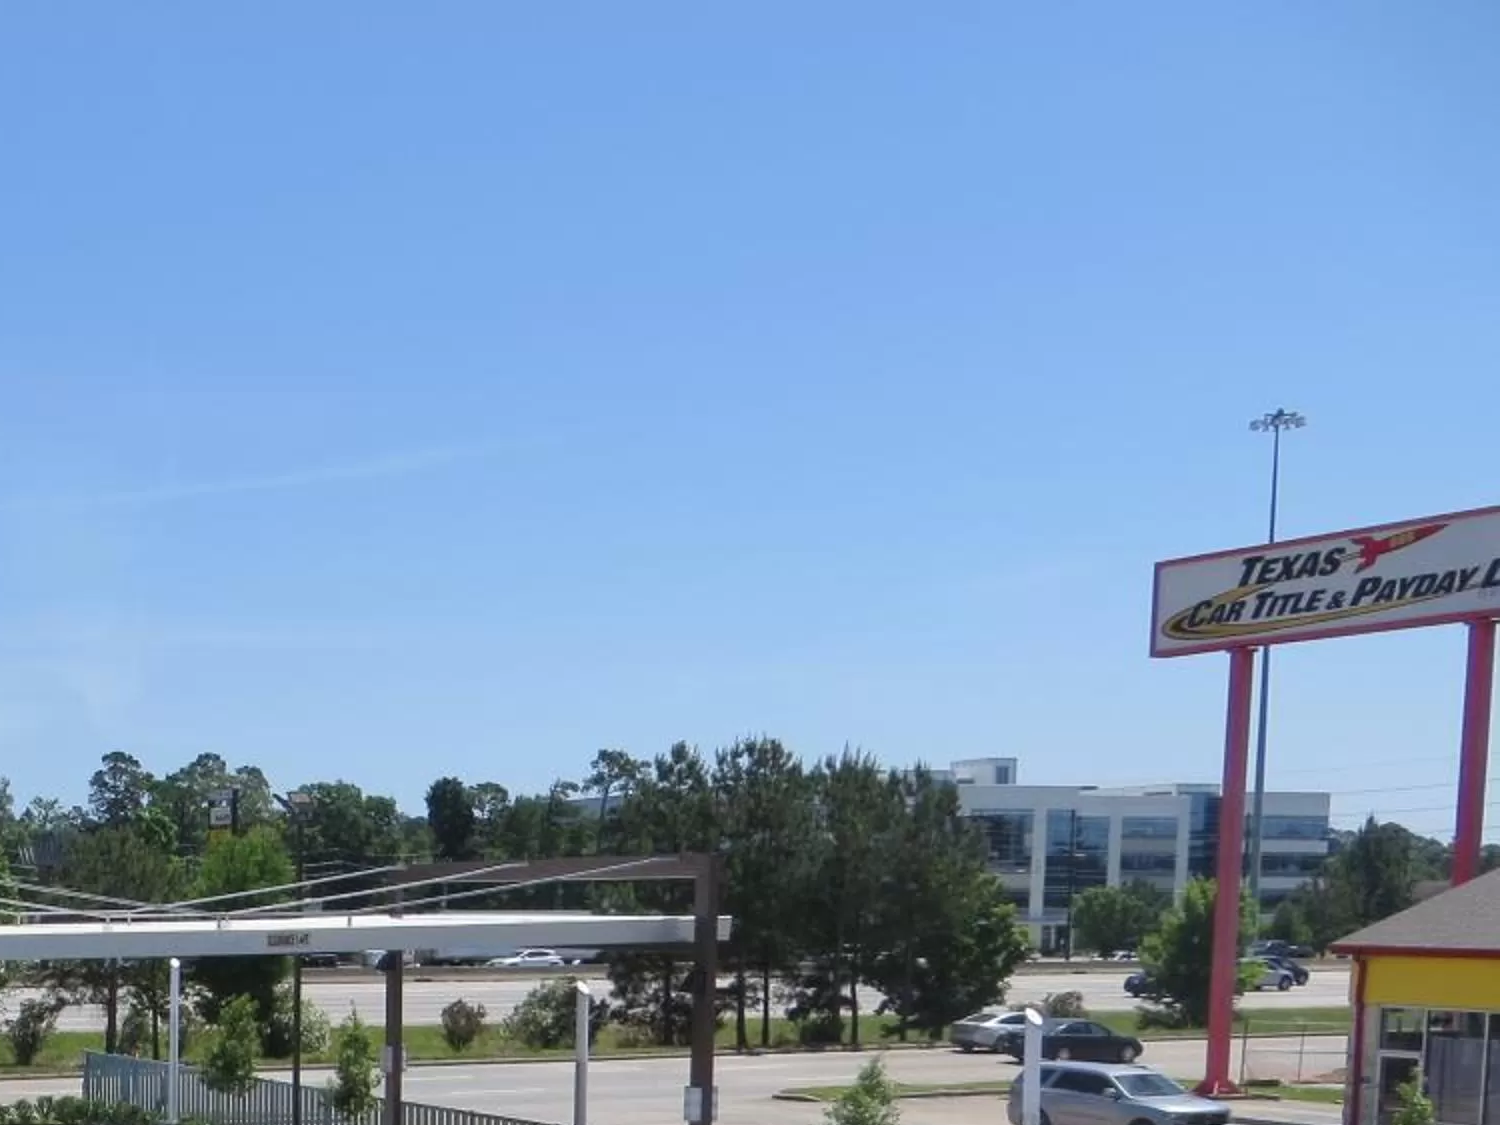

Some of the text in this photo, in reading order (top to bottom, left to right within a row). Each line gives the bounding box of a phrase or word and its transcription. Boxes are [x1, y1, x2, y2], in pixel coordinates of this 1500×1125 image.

[1237, 546, 1347, 588] TEXAS
[1188, 599, 1244, 629] CAR
[1251, 588, 1327, 621] TITLE
[1326, 591, 1346, 611] &
[1350, 564, 1481, 607] PAYDAY
